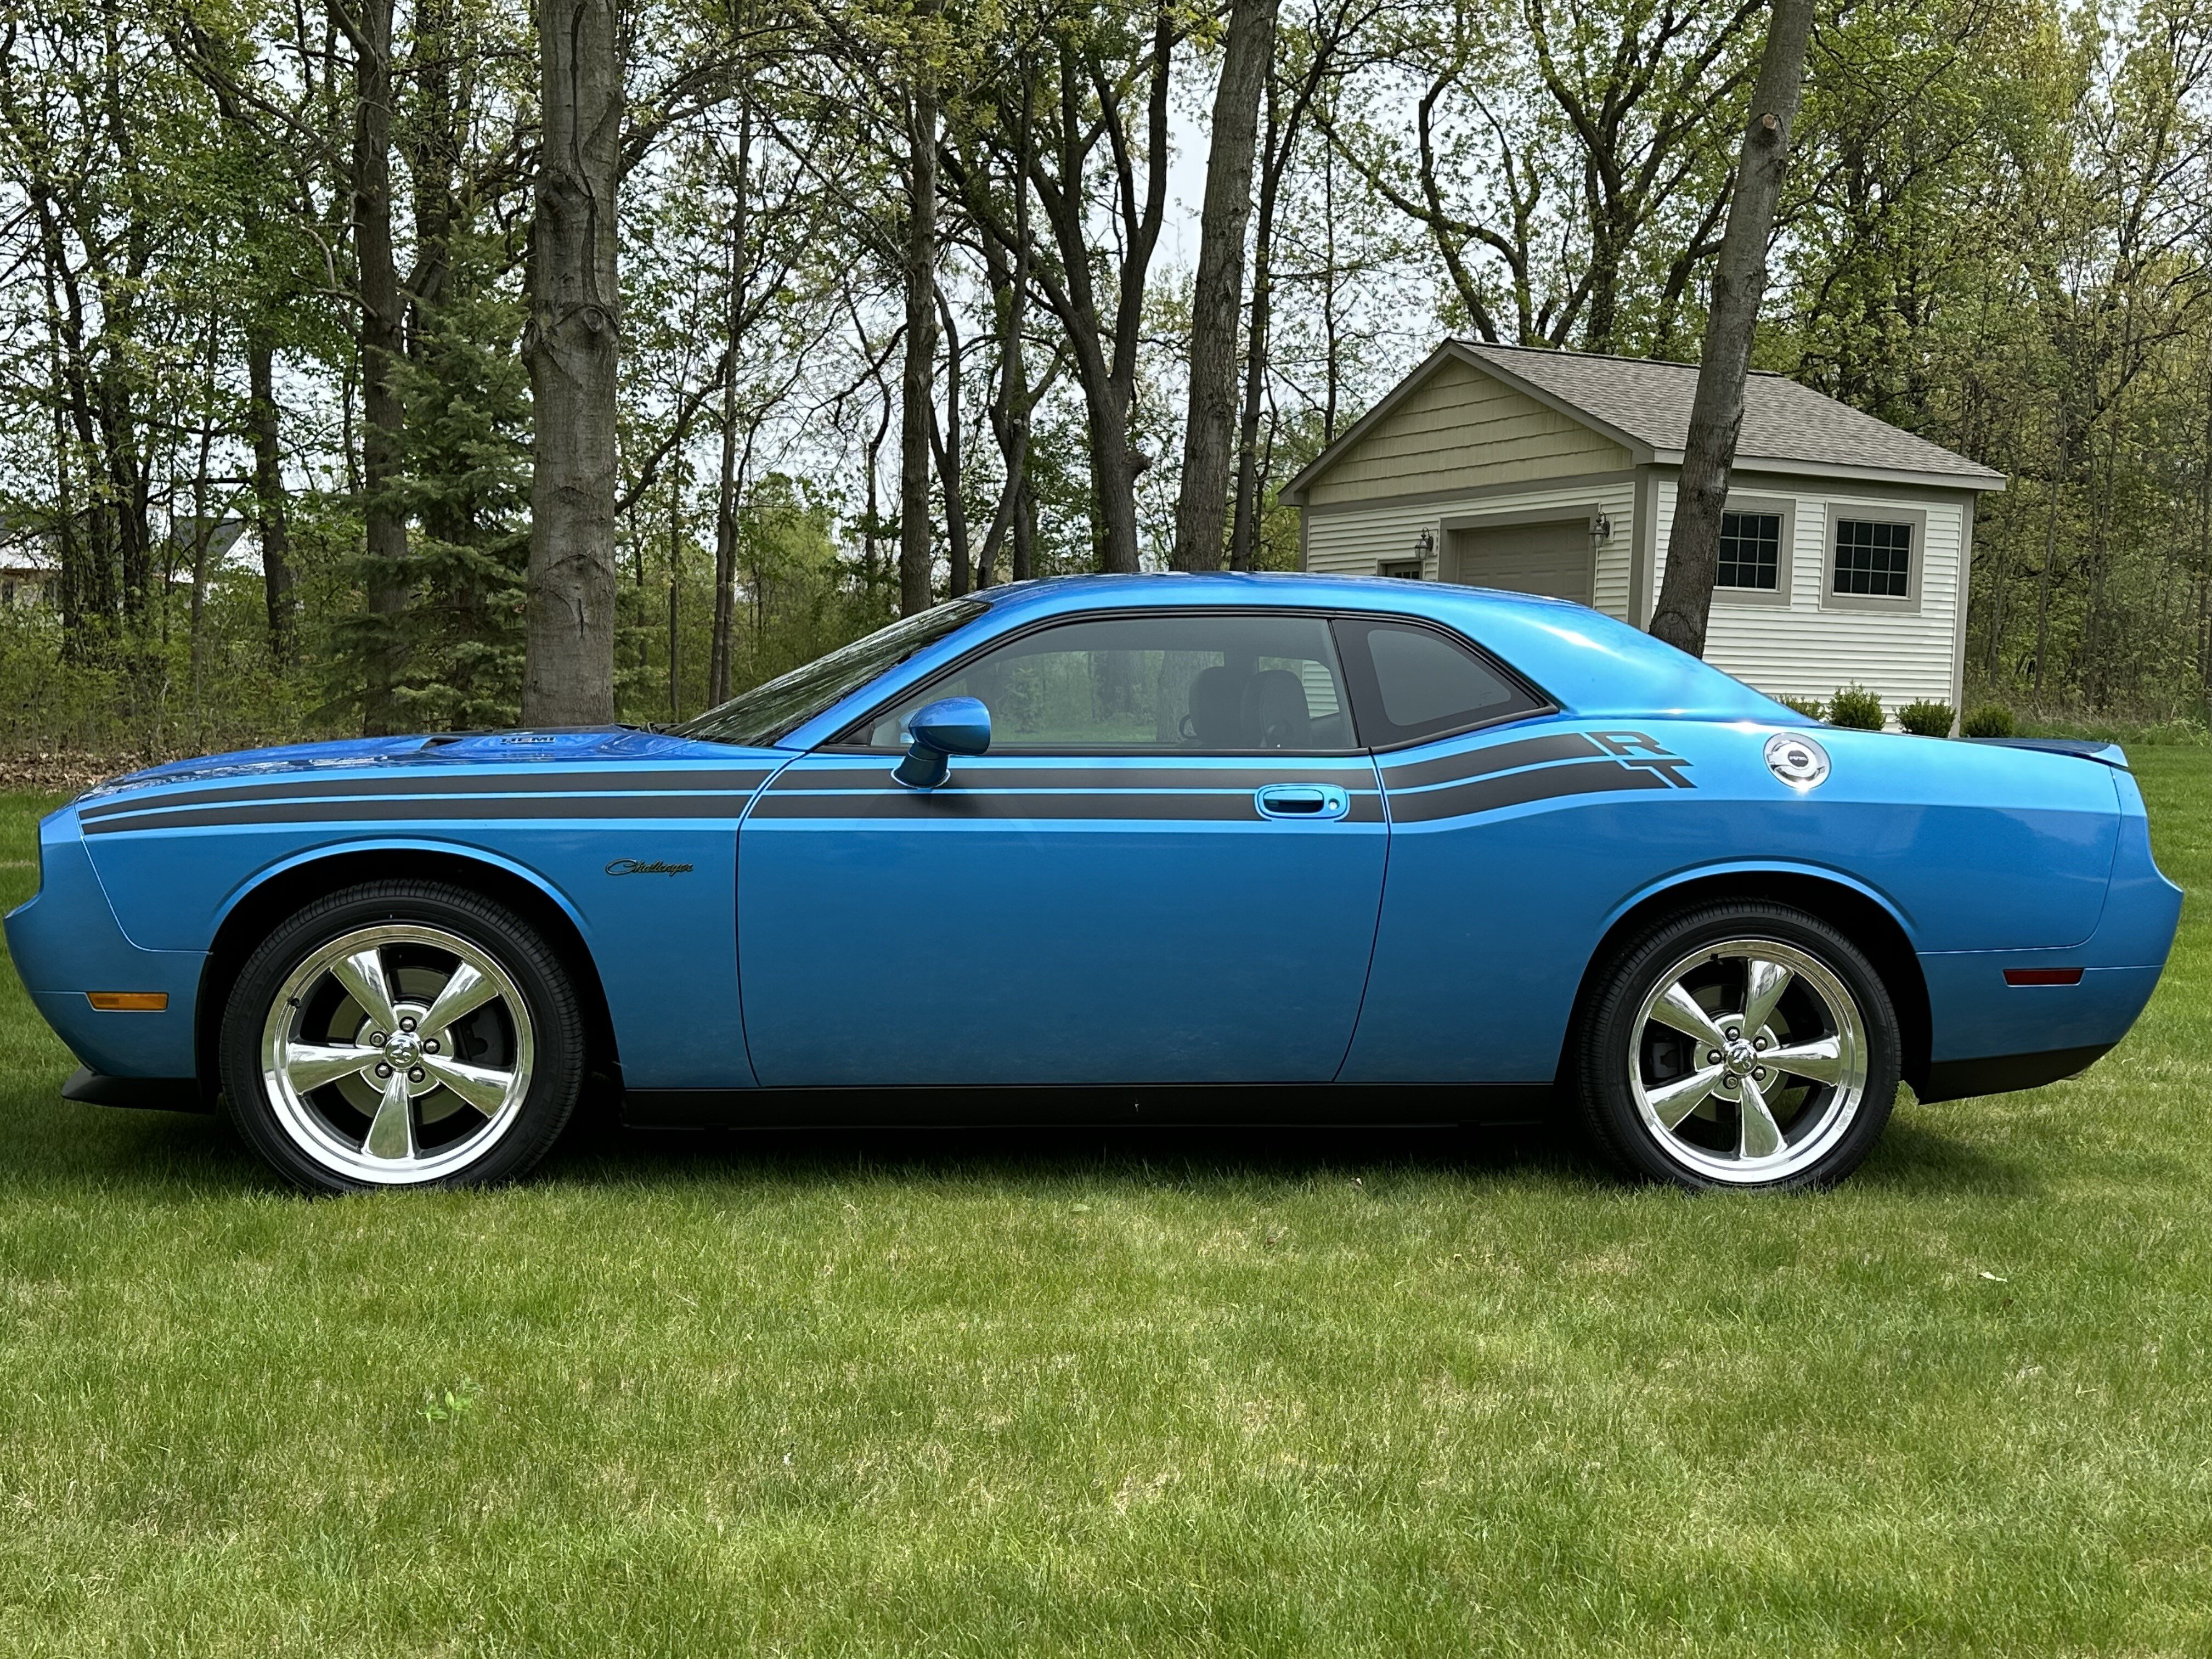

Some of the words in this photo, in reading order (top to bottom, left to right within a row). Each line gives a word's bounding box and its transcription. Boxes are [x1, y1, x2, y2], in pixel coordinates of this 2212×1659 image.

[1584, 731, 1678, 756] R
[1622, 759, 1699, 788] T
[605, 858, 694, 877] Challenger
